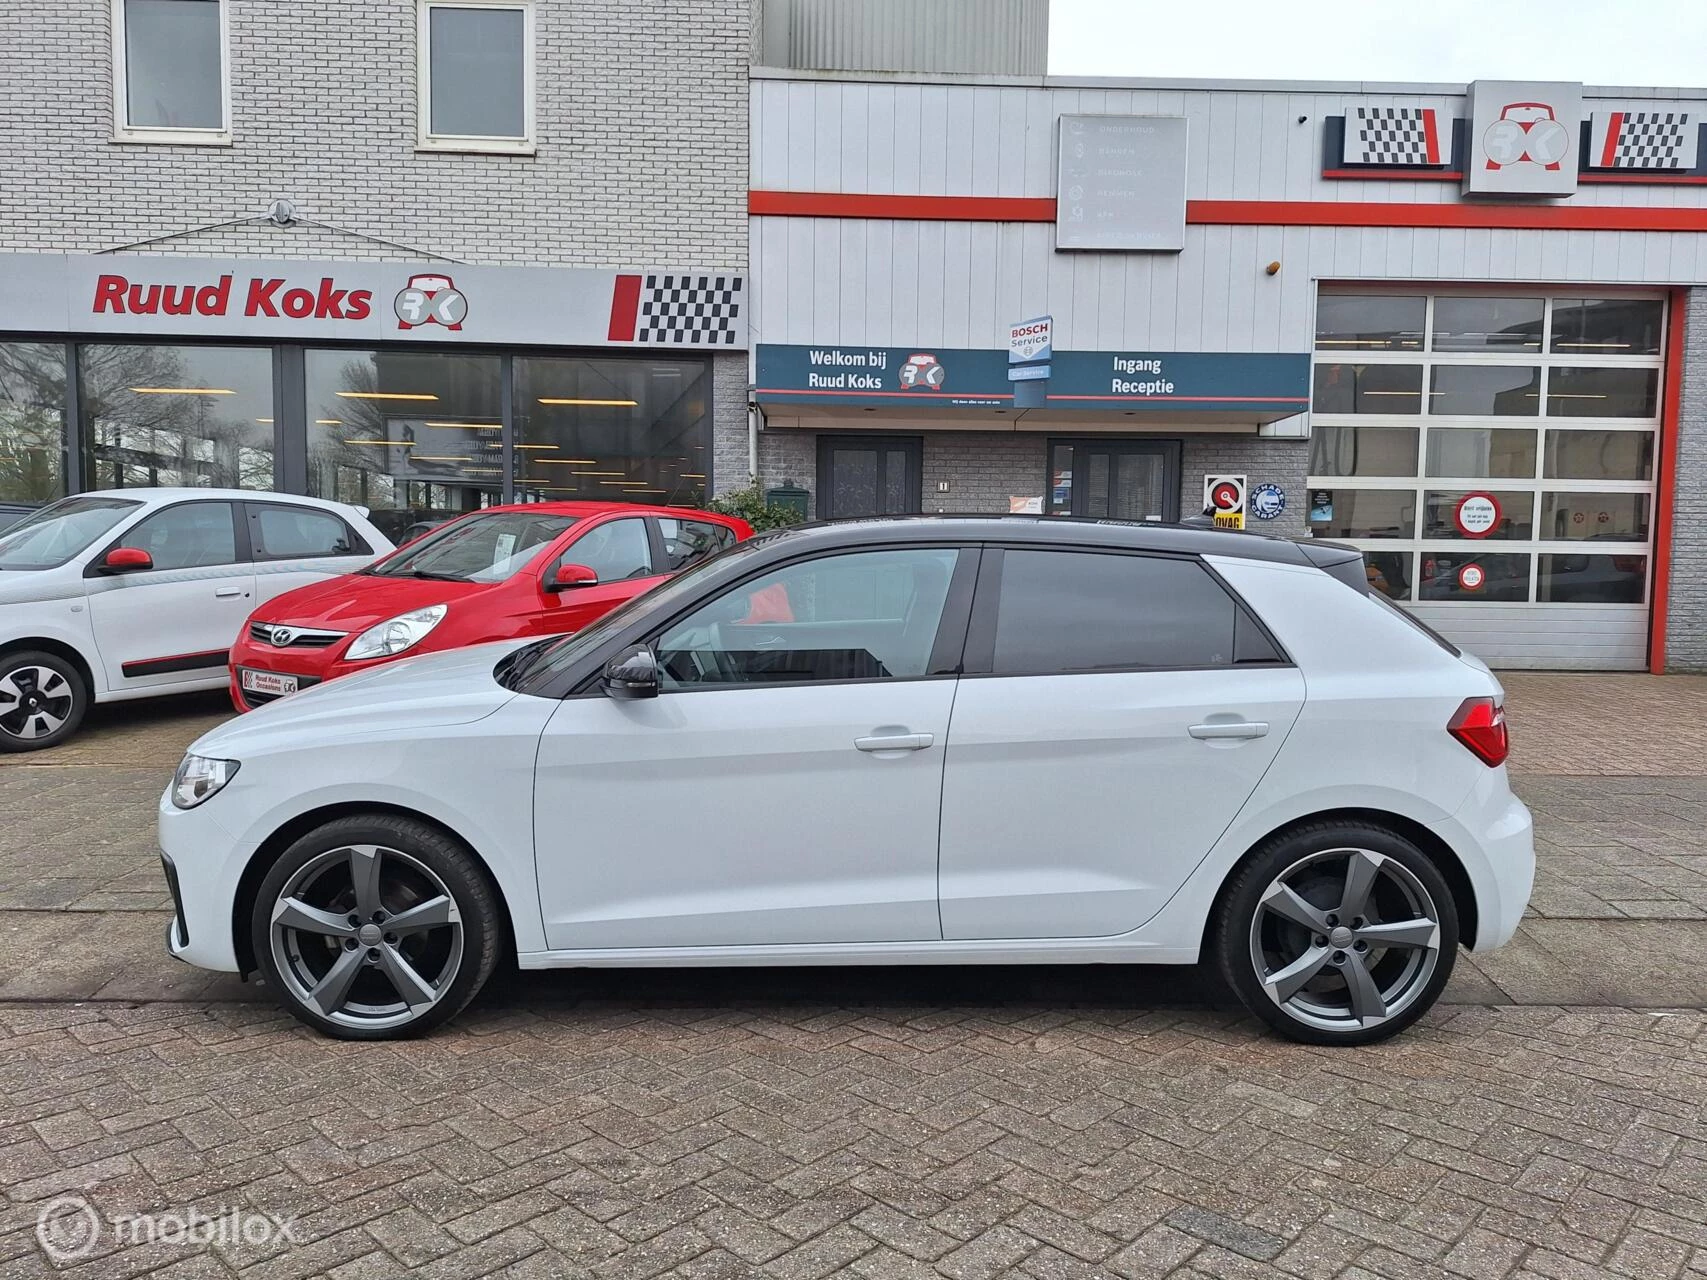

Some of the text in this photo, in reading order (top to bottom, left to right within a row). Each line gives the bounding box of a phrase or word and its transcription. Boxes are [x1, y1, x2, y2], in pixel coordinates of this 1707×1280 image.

[92, 274, 373, 320] Ruud Koks
[1012, 323, 1049, 340] BOSCH
[1011, 334, 1048, 348] Service
[809, 350, 887, 370] Welkom bij
[1113, 356, 1162, 375] Ingang
[808, 373, 882, 389] Ruud Koks
[1112, 379, 1174, 396] Receptie
[1251, 485, 1285, 500] SCHADE
[1251, 503, 1284, 519] GARANT
[1215, 516, 1240, 529] OVAG
[255, 674, 281, 684] Ruud Koks
